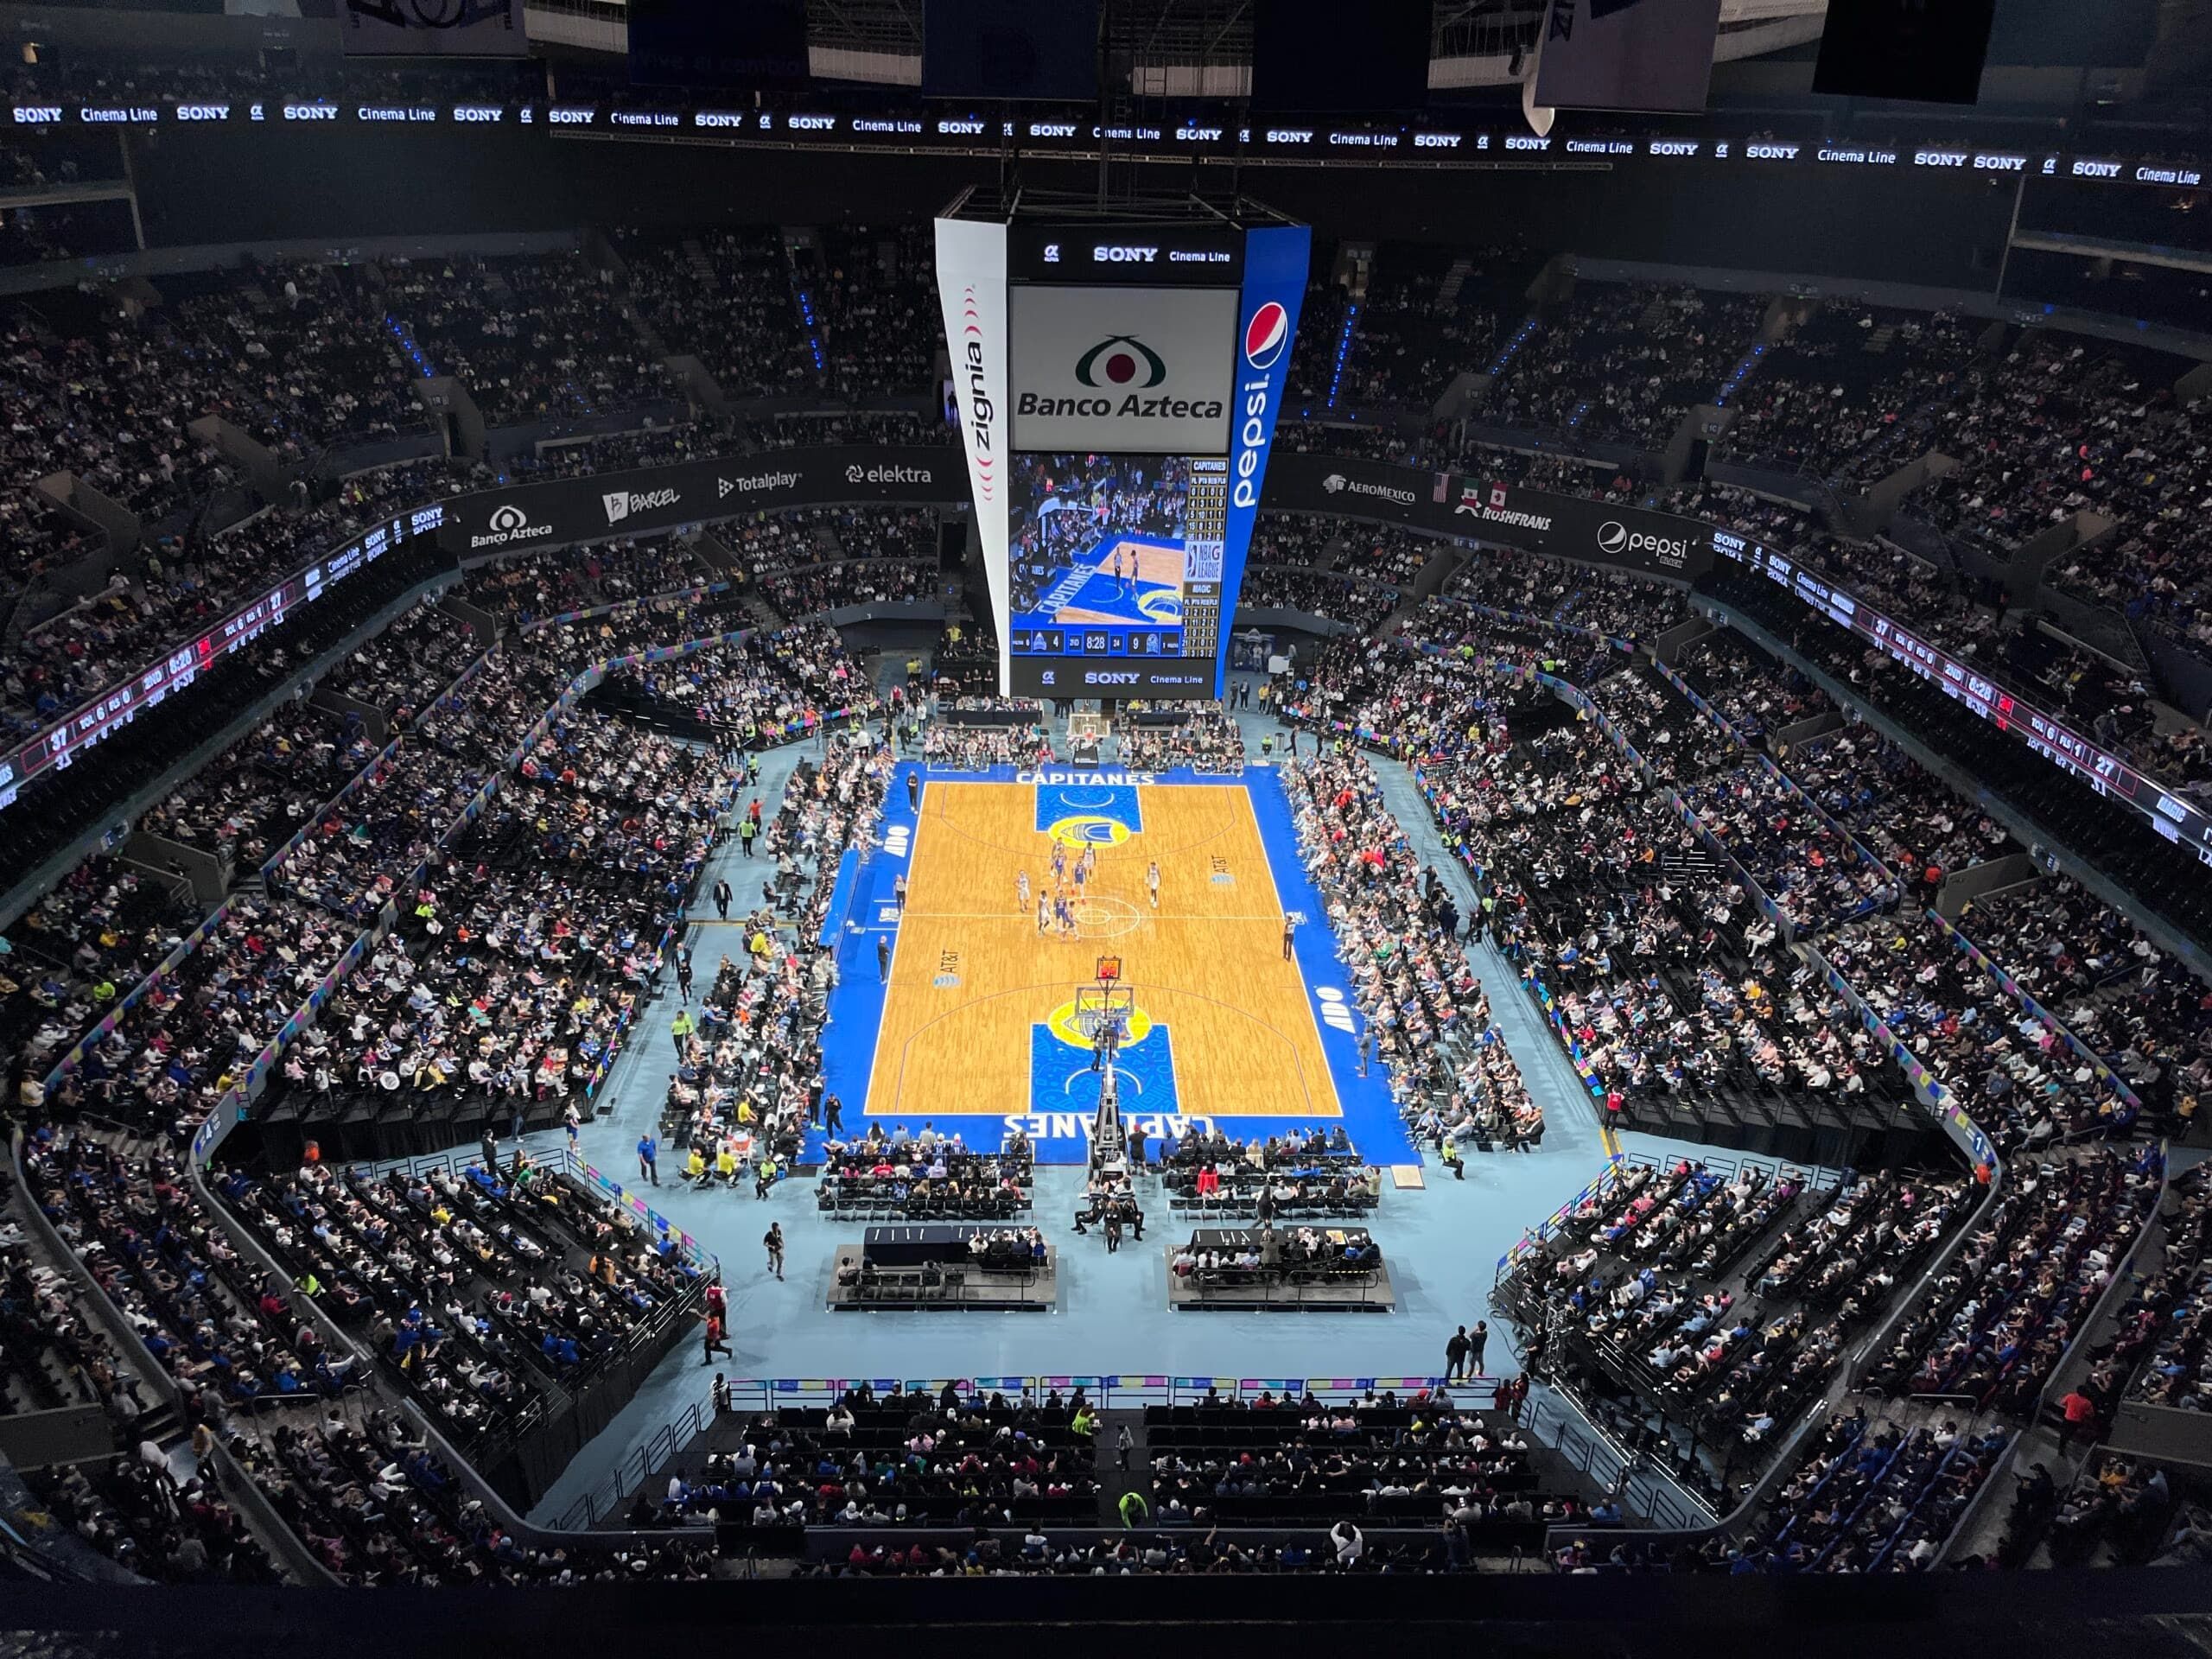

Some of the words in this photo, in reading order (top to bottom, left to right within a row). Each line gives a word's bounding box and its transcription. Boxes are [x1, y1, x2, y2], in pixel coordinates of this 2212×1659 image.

[13, 107, 62, 123] SONY
[81, 107, 128, 122] Cinema
[130, 107, 157, 122] Line
[177, 105, 229, 121] SONY
[283, 105, 338, 121] SONY
[358, 107, 407, 121] Cinema
[410, 108, 435, 121] Line
[454, 109, 503, 122] SONY
[549, 111, 594, 123] SONY
[611, 112, 652, 125] Cinema
[654, 114, 679, 125] Line
[695, 114, 741, 127] SONY
[788, 117, 835, 130] SONY
[853, 120, 893, 130] Cinema
[897, 120, 921, 132] Line
[938, 123, 984, 134] SONY
[1030, 124, 1076, 137] SONY
[1136, 128, 1160, 139] Line
[1176, 129, 1222, 140] SONY
[1267, 131, 1313, 143] SONY
[1330, 133, 1370, 145] Cinema
[1373, 134, 1398, 146] Line
[1414, 135, 1460, 147] SONY
[1505, 137, 1551, 149] SONY
[1566, 141, 1605, 153] Cinema
[1609, 142, 1633, 154] Line
[1649, 143, 1698, 156] SONY
[1746, 146, 1799, 159] SONY
[1817, 149, 1865, 163] Cinema
[1868, 151, 1896, 164] Line
[1915, 152, 1967, 167] SONY
[1974, 155, 2026, 170] SONY
[2073, 162, 2121, 177] SONY
[2136, 167, 2176, 183] Cinema
[2177, 169, 2201, 185] Line
[1094, 246, 1158, 262] SONY
[1169, 251, 1205, 262] Cinema
[1209, 251, 1230, 262] Line
[965, 341, 993, 451] zignia
[1017, 393, 1111, 416] Banco
[1116, 394, 1223, 418] Azteca
[1234, 380, 1267, 508] pepsi
[1193, 461, 1226, 471] CAPITANES
[736, 471, 798, 492] Totalplay
[868, 465, 931, 483] elektra
[629, 488, 681, 513] BARCEL
[410, 506, 442, 526] SONY
[1482, 506, 1551, 531] ROSHFRANS
[365, 528, 385, 550] SONY
[471, 532, 506, 548] Banco
[509, 524, 552, 541] Azteca
[1713, 532, 1746, 551] SONY
[1199, 545, 1211, 560] NBA
[1212, 545, 1220, 560] G
[1628, 532, 1688, 559] pepsi
[1198, 563, 1220, 577] LEAGUE
[1769, 555, 1792, 575] SONY
[1037, 563, 1097, 614] CAPITANES
[1192, 585, 1211, 594] MAGIC
[1052, 636, 1058, 647] 4
[1087, 636, 1104, 649] 8:28
[1133, 638, 1139, 649] 9
[143, 671, 162, 690] 2ND
[1085, 673, 1140, 683] SONY
[1875, 620, 1889, 636] 37
[1944, 663, 1962, 682] 2ND
[1968, 677, 1992, 702] 8:28
[2047, 725, 2054, 740] 6
[2059, 734, 2071, 750] FLS
[2074, 743, 2081, 758] 1
[2096, 755, 2113, 777] 27
[1016, 773, 1155, 785] CAPITANES
[2157, 796, 2186, 823] MAGIC
[883, 826, 910, 858] ADO
[1211, 855, 1230, 874] AT&T
[940, 950, 958, 974] AT&T
[1316, 987, 1356, 1034] ADO
